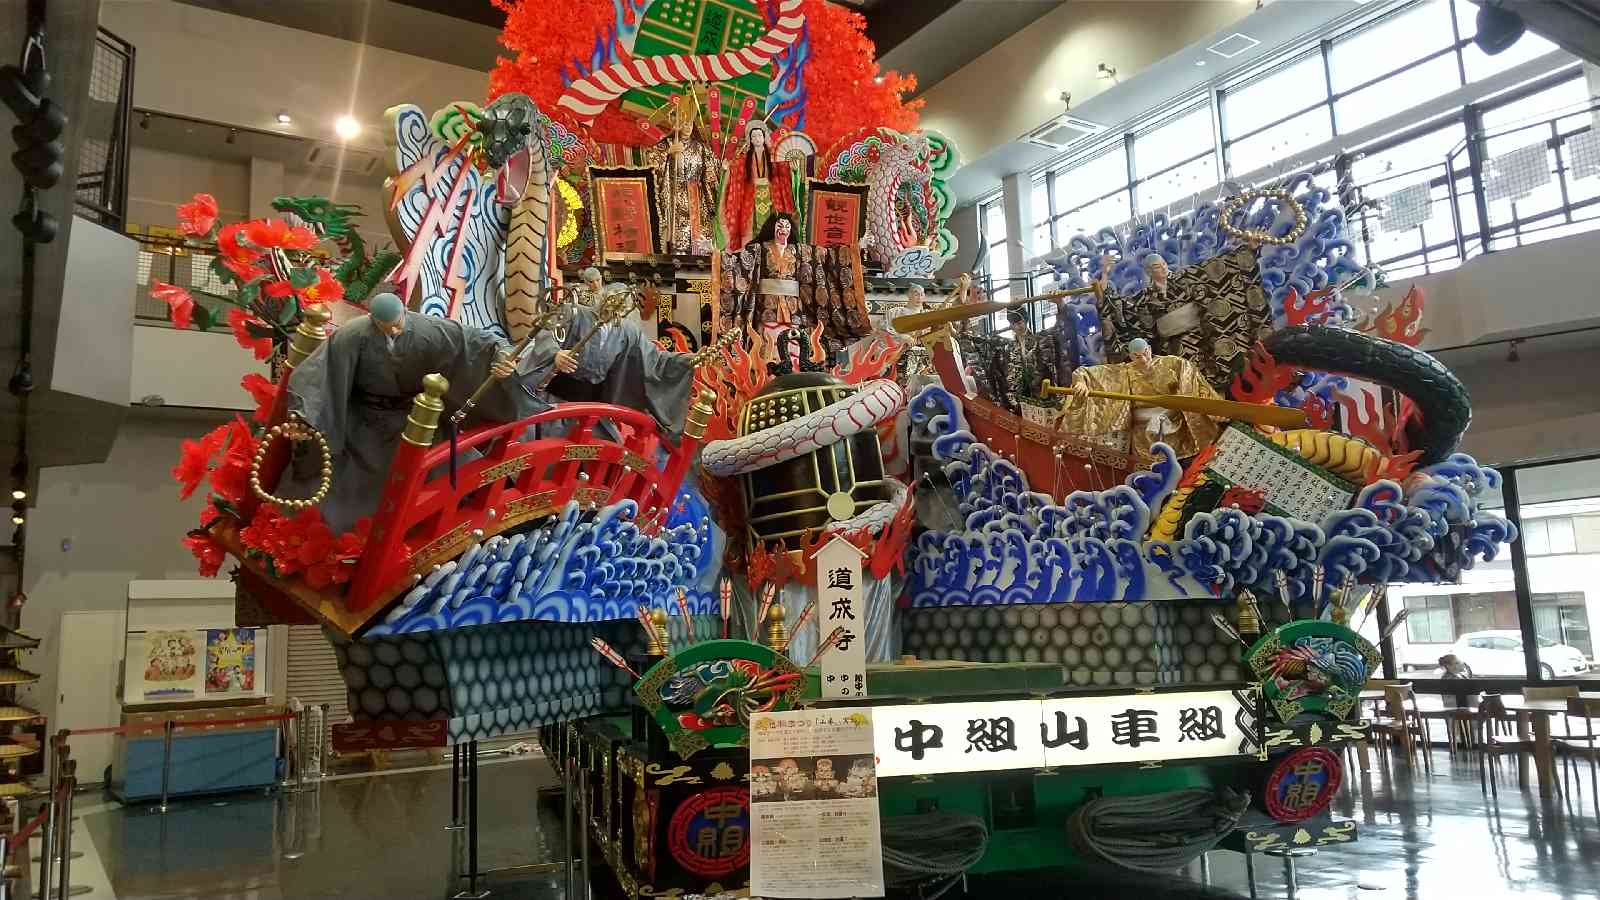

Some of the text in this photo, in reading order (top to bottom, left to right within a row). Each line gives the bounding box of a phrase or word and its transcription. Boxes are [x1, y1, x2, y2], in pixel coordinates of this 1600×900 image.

[894, 705, 1227, 760] 中組山車組
